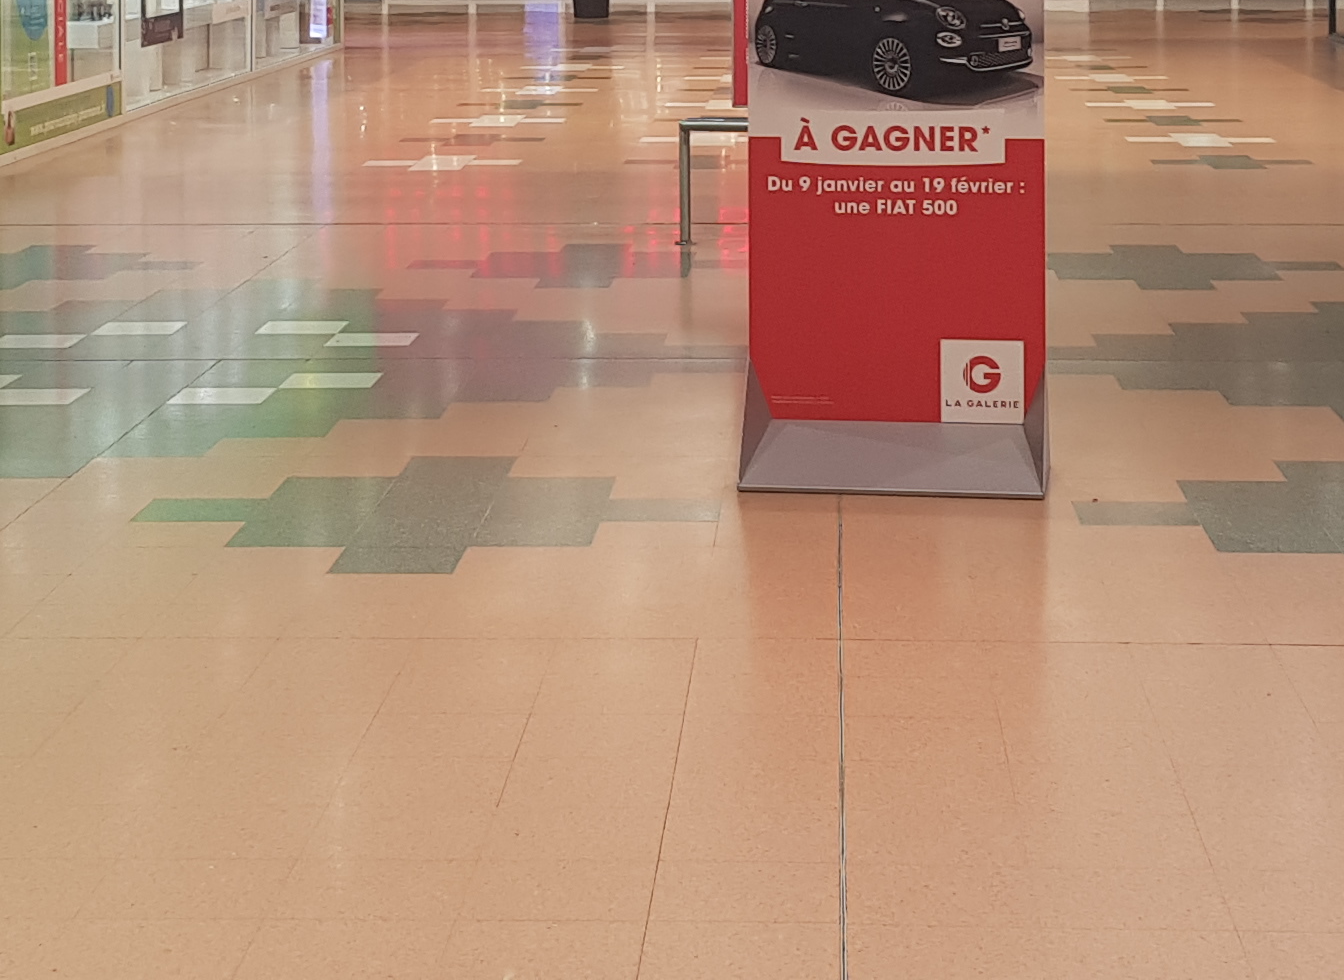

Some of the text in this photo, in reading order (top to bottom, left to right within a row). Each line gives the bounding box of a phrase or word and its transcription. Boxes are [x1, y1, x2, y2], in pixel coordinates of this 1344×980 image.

[794, 117, 818, 151] À
[767, 177, 794, 192] Du
[798, 177, 811, 192] 9
[816, 177, 885, 195] janvier
[889, 180, 915, 193] au
[922, 177, 945, 193] 19
[950, 177, 1014, 195] février
[834, 199, 958, 216] une FIAT 500
[945, 399, 1020, 409] LA GALERIE
